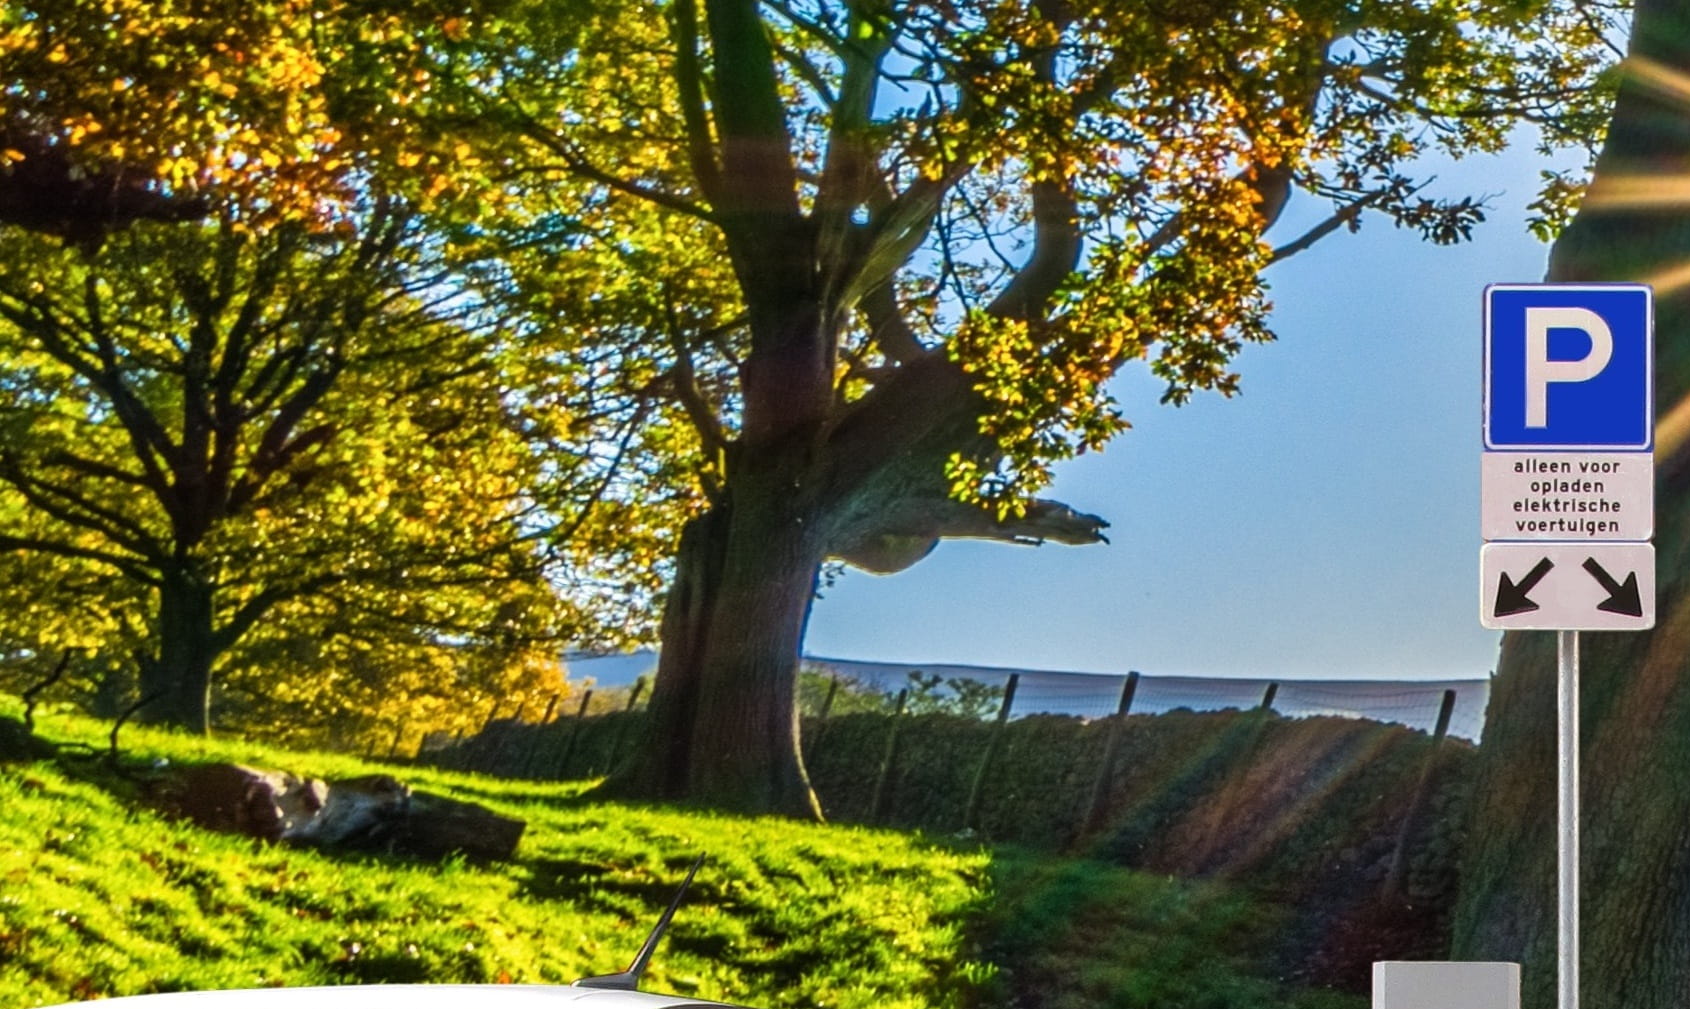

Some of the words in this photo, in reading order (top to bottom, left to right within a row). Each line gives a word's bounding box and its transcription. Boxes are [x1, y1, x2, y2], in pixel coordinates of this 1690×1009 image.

[1525, 307, 1613, 429] P
[1514, 459, 1571, 473] alleen
[1579, 461, 1621, 474] voor
[1530, 478, 1604, 495] opladen
[1513, 498, 1621, 512] elektrische
[1516, 518, 1619, 536] voertuigen
